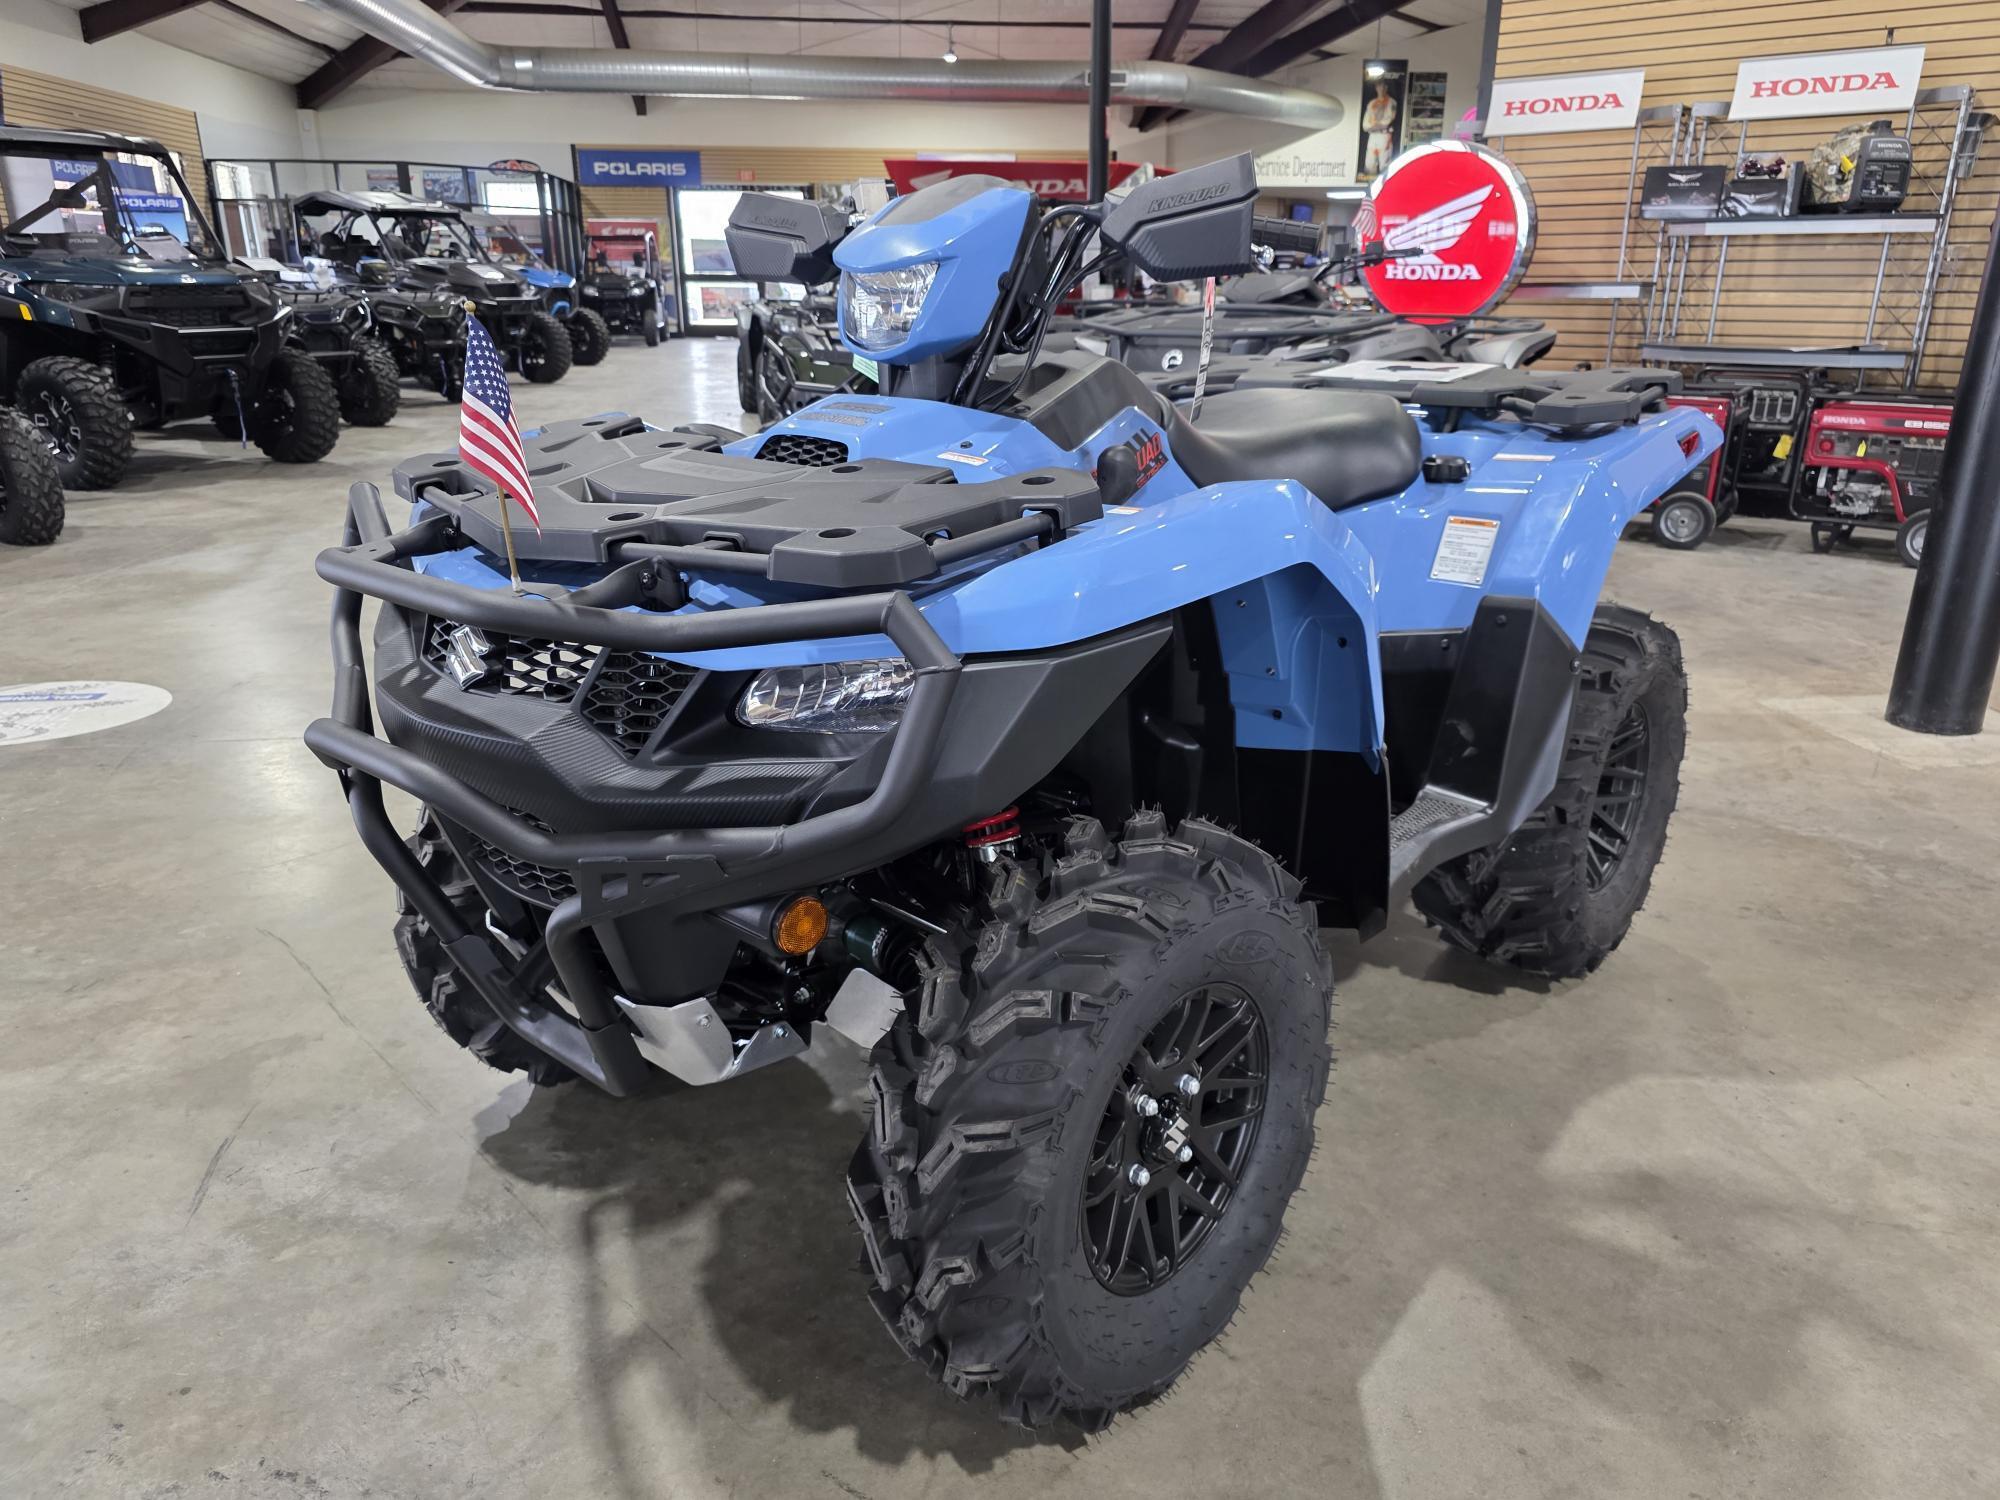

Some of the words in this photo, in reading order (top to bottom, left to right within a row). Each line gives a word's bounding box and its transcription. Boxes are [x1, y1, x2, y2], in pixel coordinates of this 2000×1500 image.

[1750, 72, 1899, 98] HONDA
[1503, 93, 1624, 117] HONDA
[593, 162, 687, 176] POLARIS
[1292, 156, 1346, 183] Department
[1385, 264, 1482, 280] HONDA
[1822, 415, 1866, 425] HONDA
